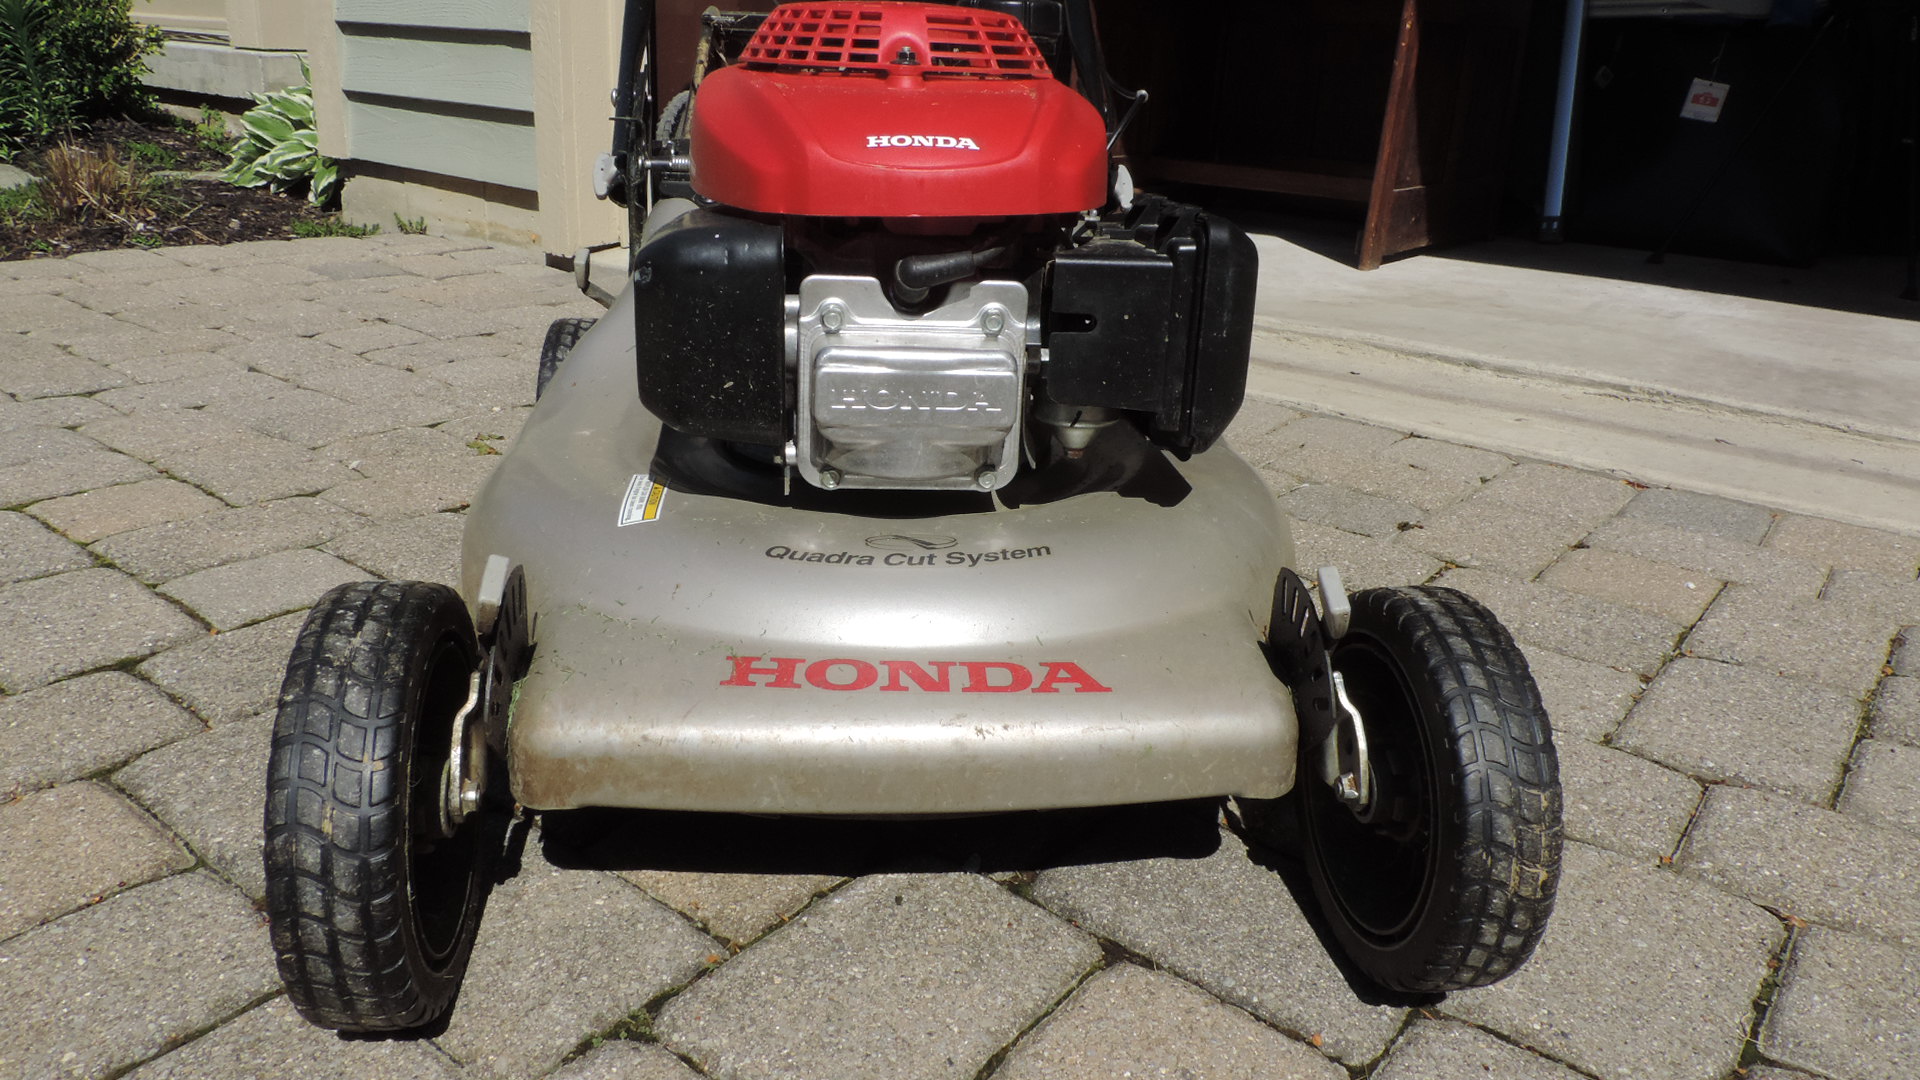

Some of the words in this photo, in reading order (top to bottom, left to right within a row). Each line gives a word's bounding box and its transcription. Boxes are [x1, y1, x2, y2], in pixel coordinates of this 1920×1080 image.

[866, 135, 980, 150] HONDA
[831, 389, 1002, 411] HONDA
[765, 545, 873, 566] Quadra
[883, 552, 937, 566] Cut
[945, 545, 1051, 567] System
[719, 656, 1112, 693] HONDA
